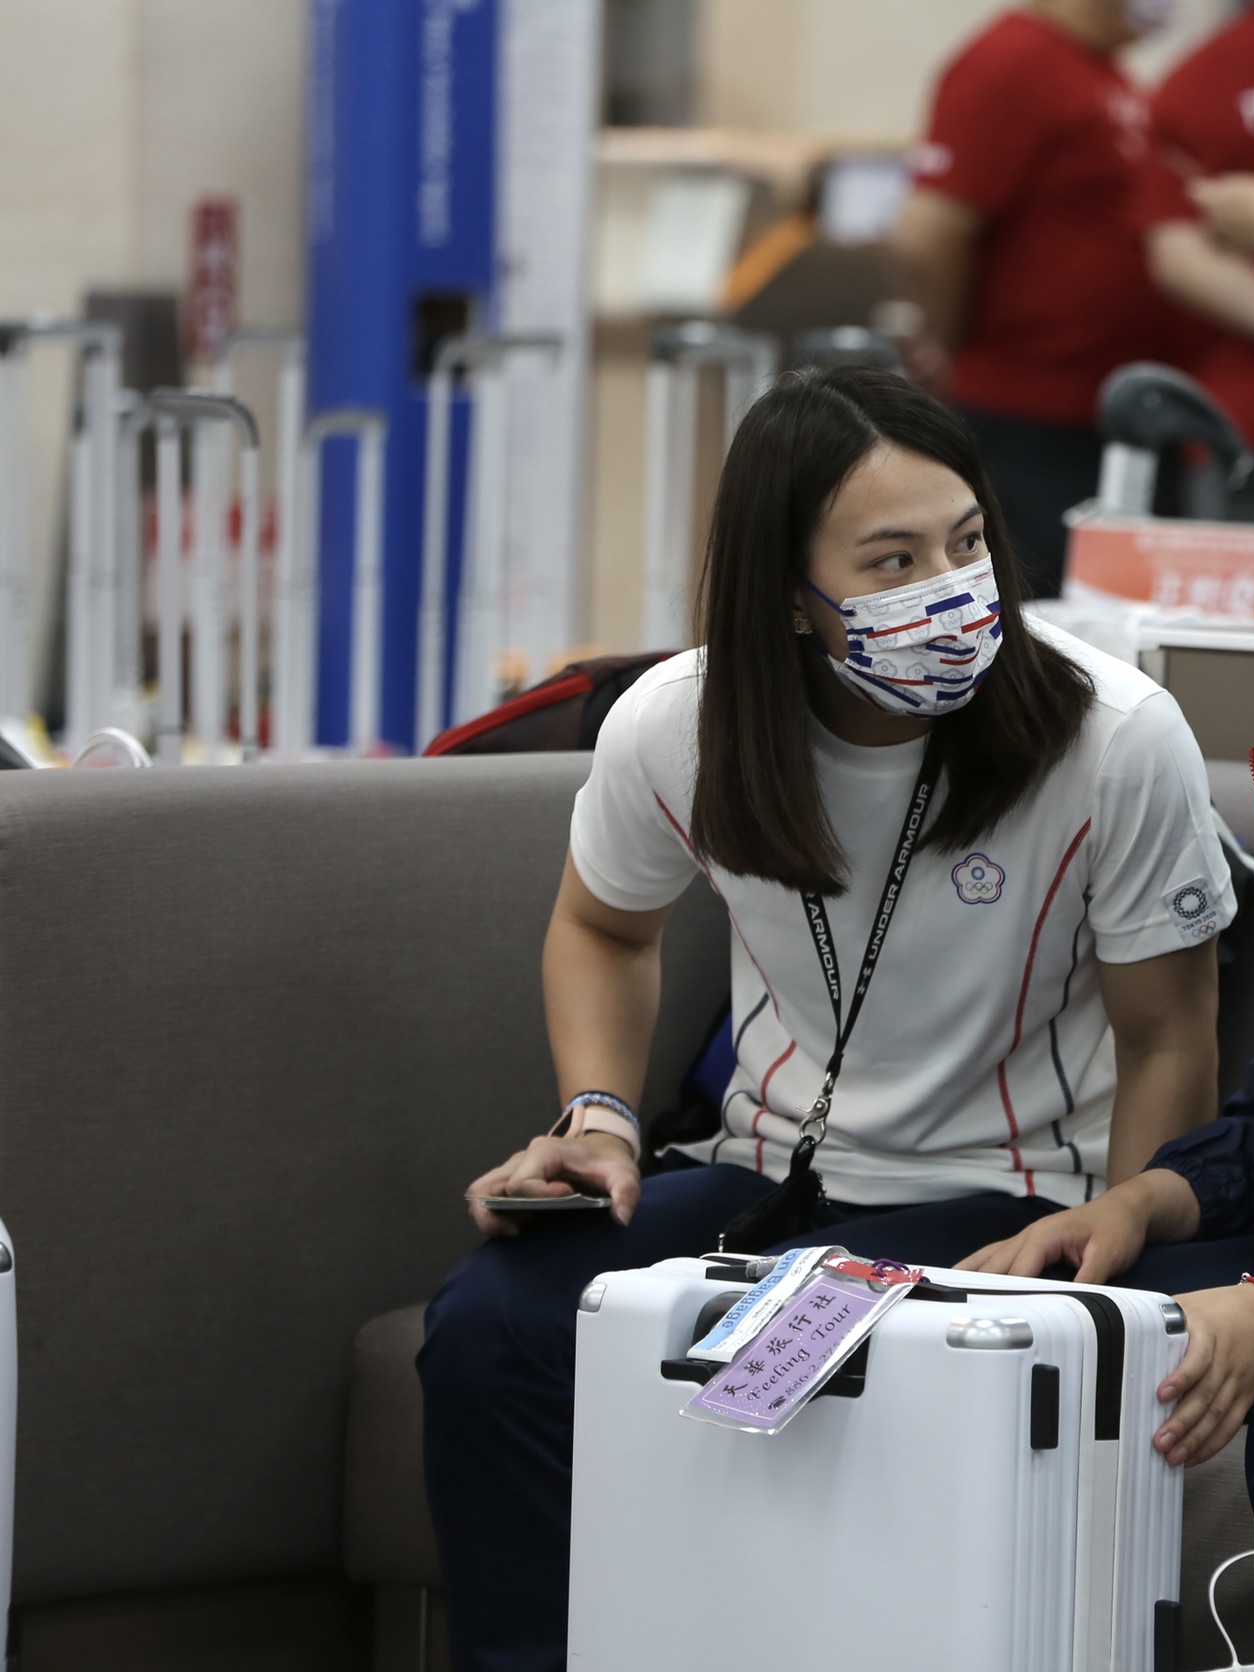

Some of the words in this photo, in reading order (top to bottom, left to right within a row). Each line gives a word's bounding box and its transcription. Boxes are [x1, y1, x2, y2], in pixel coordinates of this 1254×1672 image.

[868, 883, 899, 960] UNDER
[894, 783, 930, 882] ARMOUR
[807, 901, 840, 1000] ARMOUR
[1182, 919, 1203, 932] TOKYO
[722, 1275, 784, 1329] Baggage
[747, 1348, 811, 1401] Feeling
[810, 1304, 851, 1341] Tour
